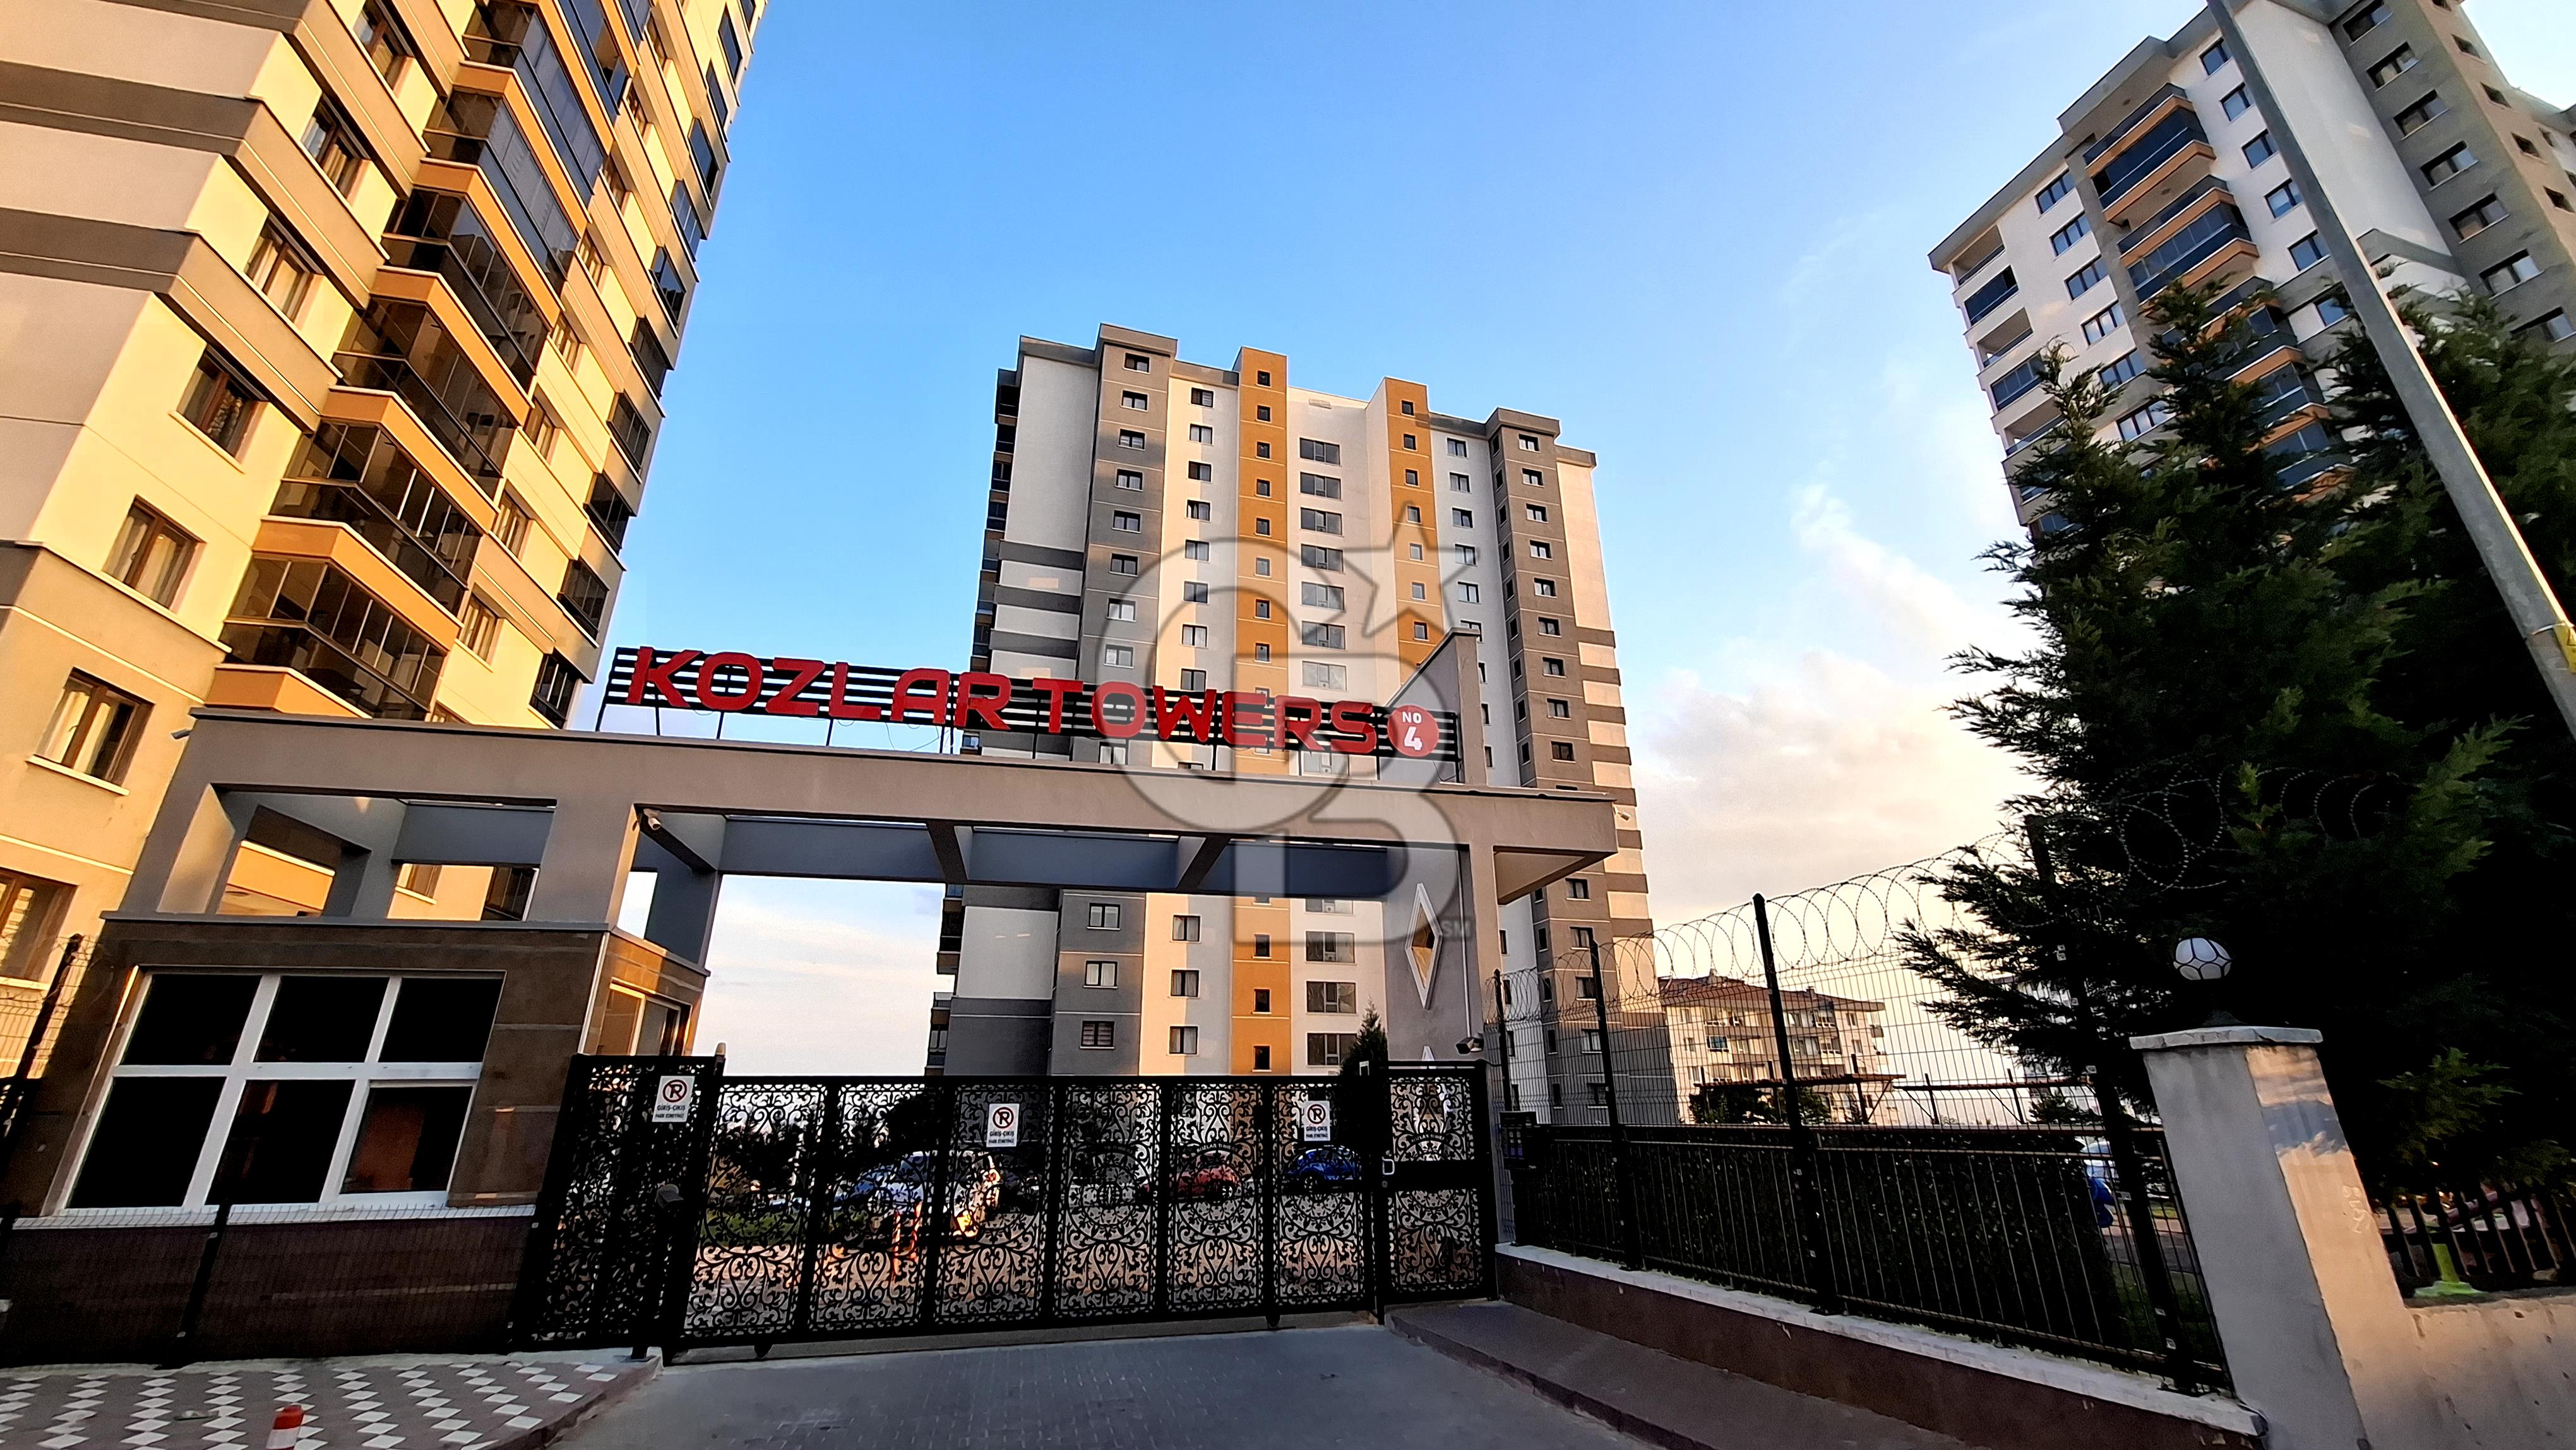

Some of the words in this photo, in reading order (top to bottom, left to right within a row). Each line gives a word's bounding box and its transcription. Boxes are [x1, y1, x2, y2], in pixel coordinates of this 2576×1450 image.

[625, 646, 1011, 731] KOZLAR
[1032, 677, 1376, 754] TOWERS
[1402, 711, 1422, 724] NO
[1404, 726, 1422, 751] 4
